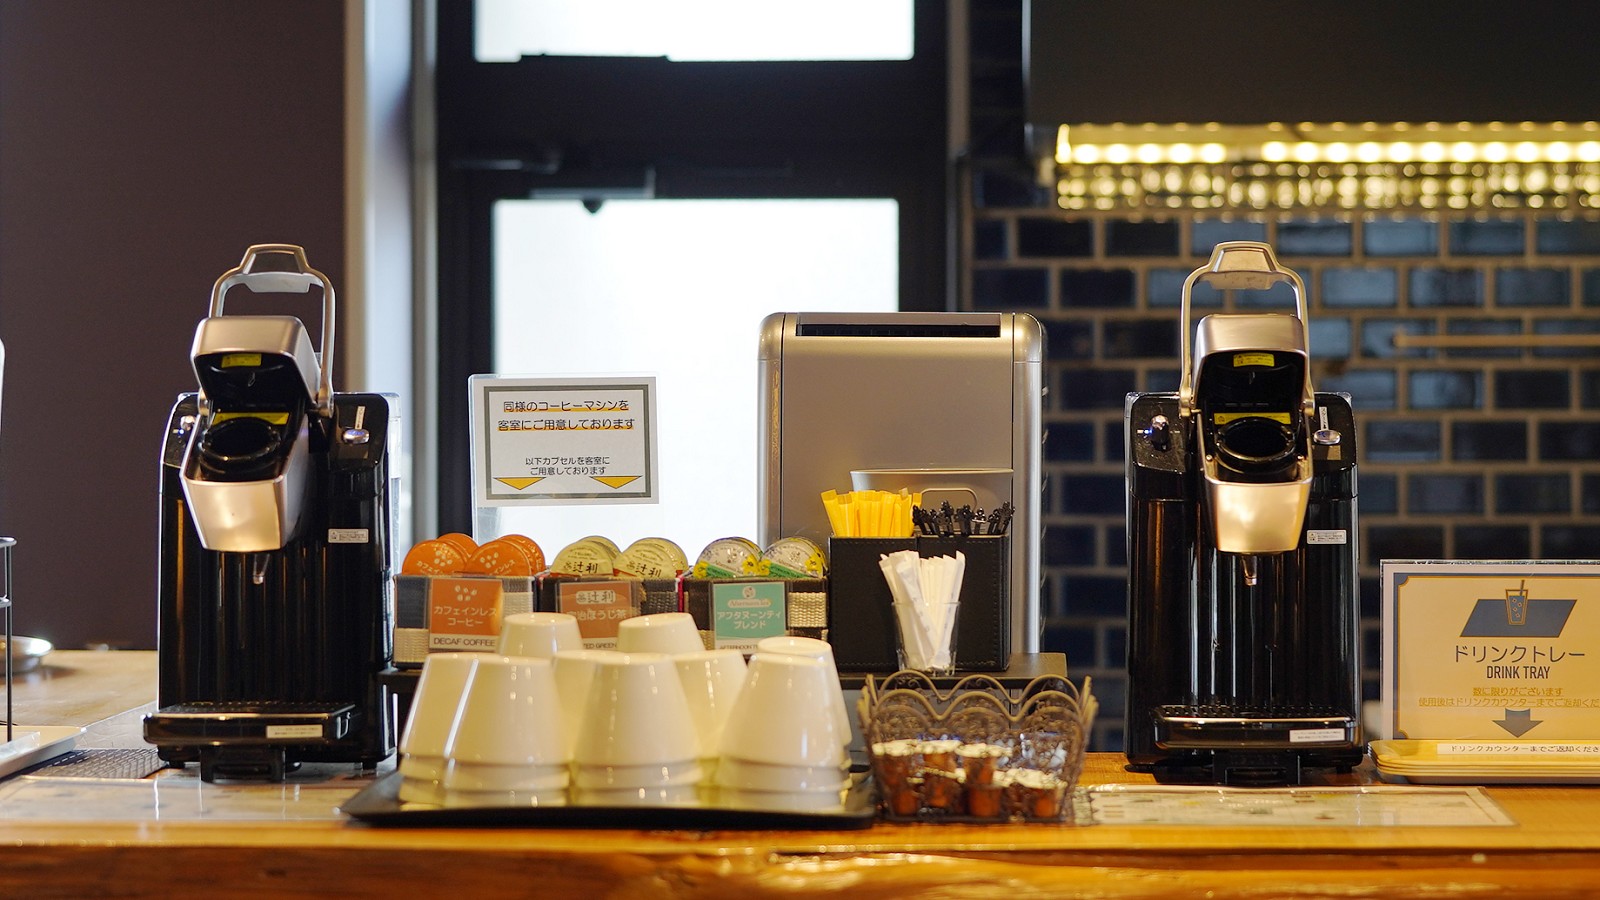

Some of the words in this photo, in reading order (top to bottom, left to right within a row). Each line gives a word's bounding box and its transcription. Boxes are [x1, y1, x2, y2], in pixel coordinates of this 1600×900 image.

[503, 400, 629, 413] 同様のコーヒーマシンを
[498, 418, 635, 431] 客室にご用意しております
[530, 466, 606, 476] ご用意しております
[433, 605, 498, 617] カフェインレス
[716, 610, 781, 620] アフタヌーンティ
[447, 617, 484, 627] コーヒー
[734, 620, 767, 629] ブレンド
[433, 637, 461, 645] DECAF
[463, 638, 495, 647] COFFEE
[1454, 645, 1585, 663] ドリンクトレー
[1486, 665, 1520, 679] DRINK
[1523, 665, 1551, 679] TRAY
[1472, 686, 1563, 697] 数に限りがございます
